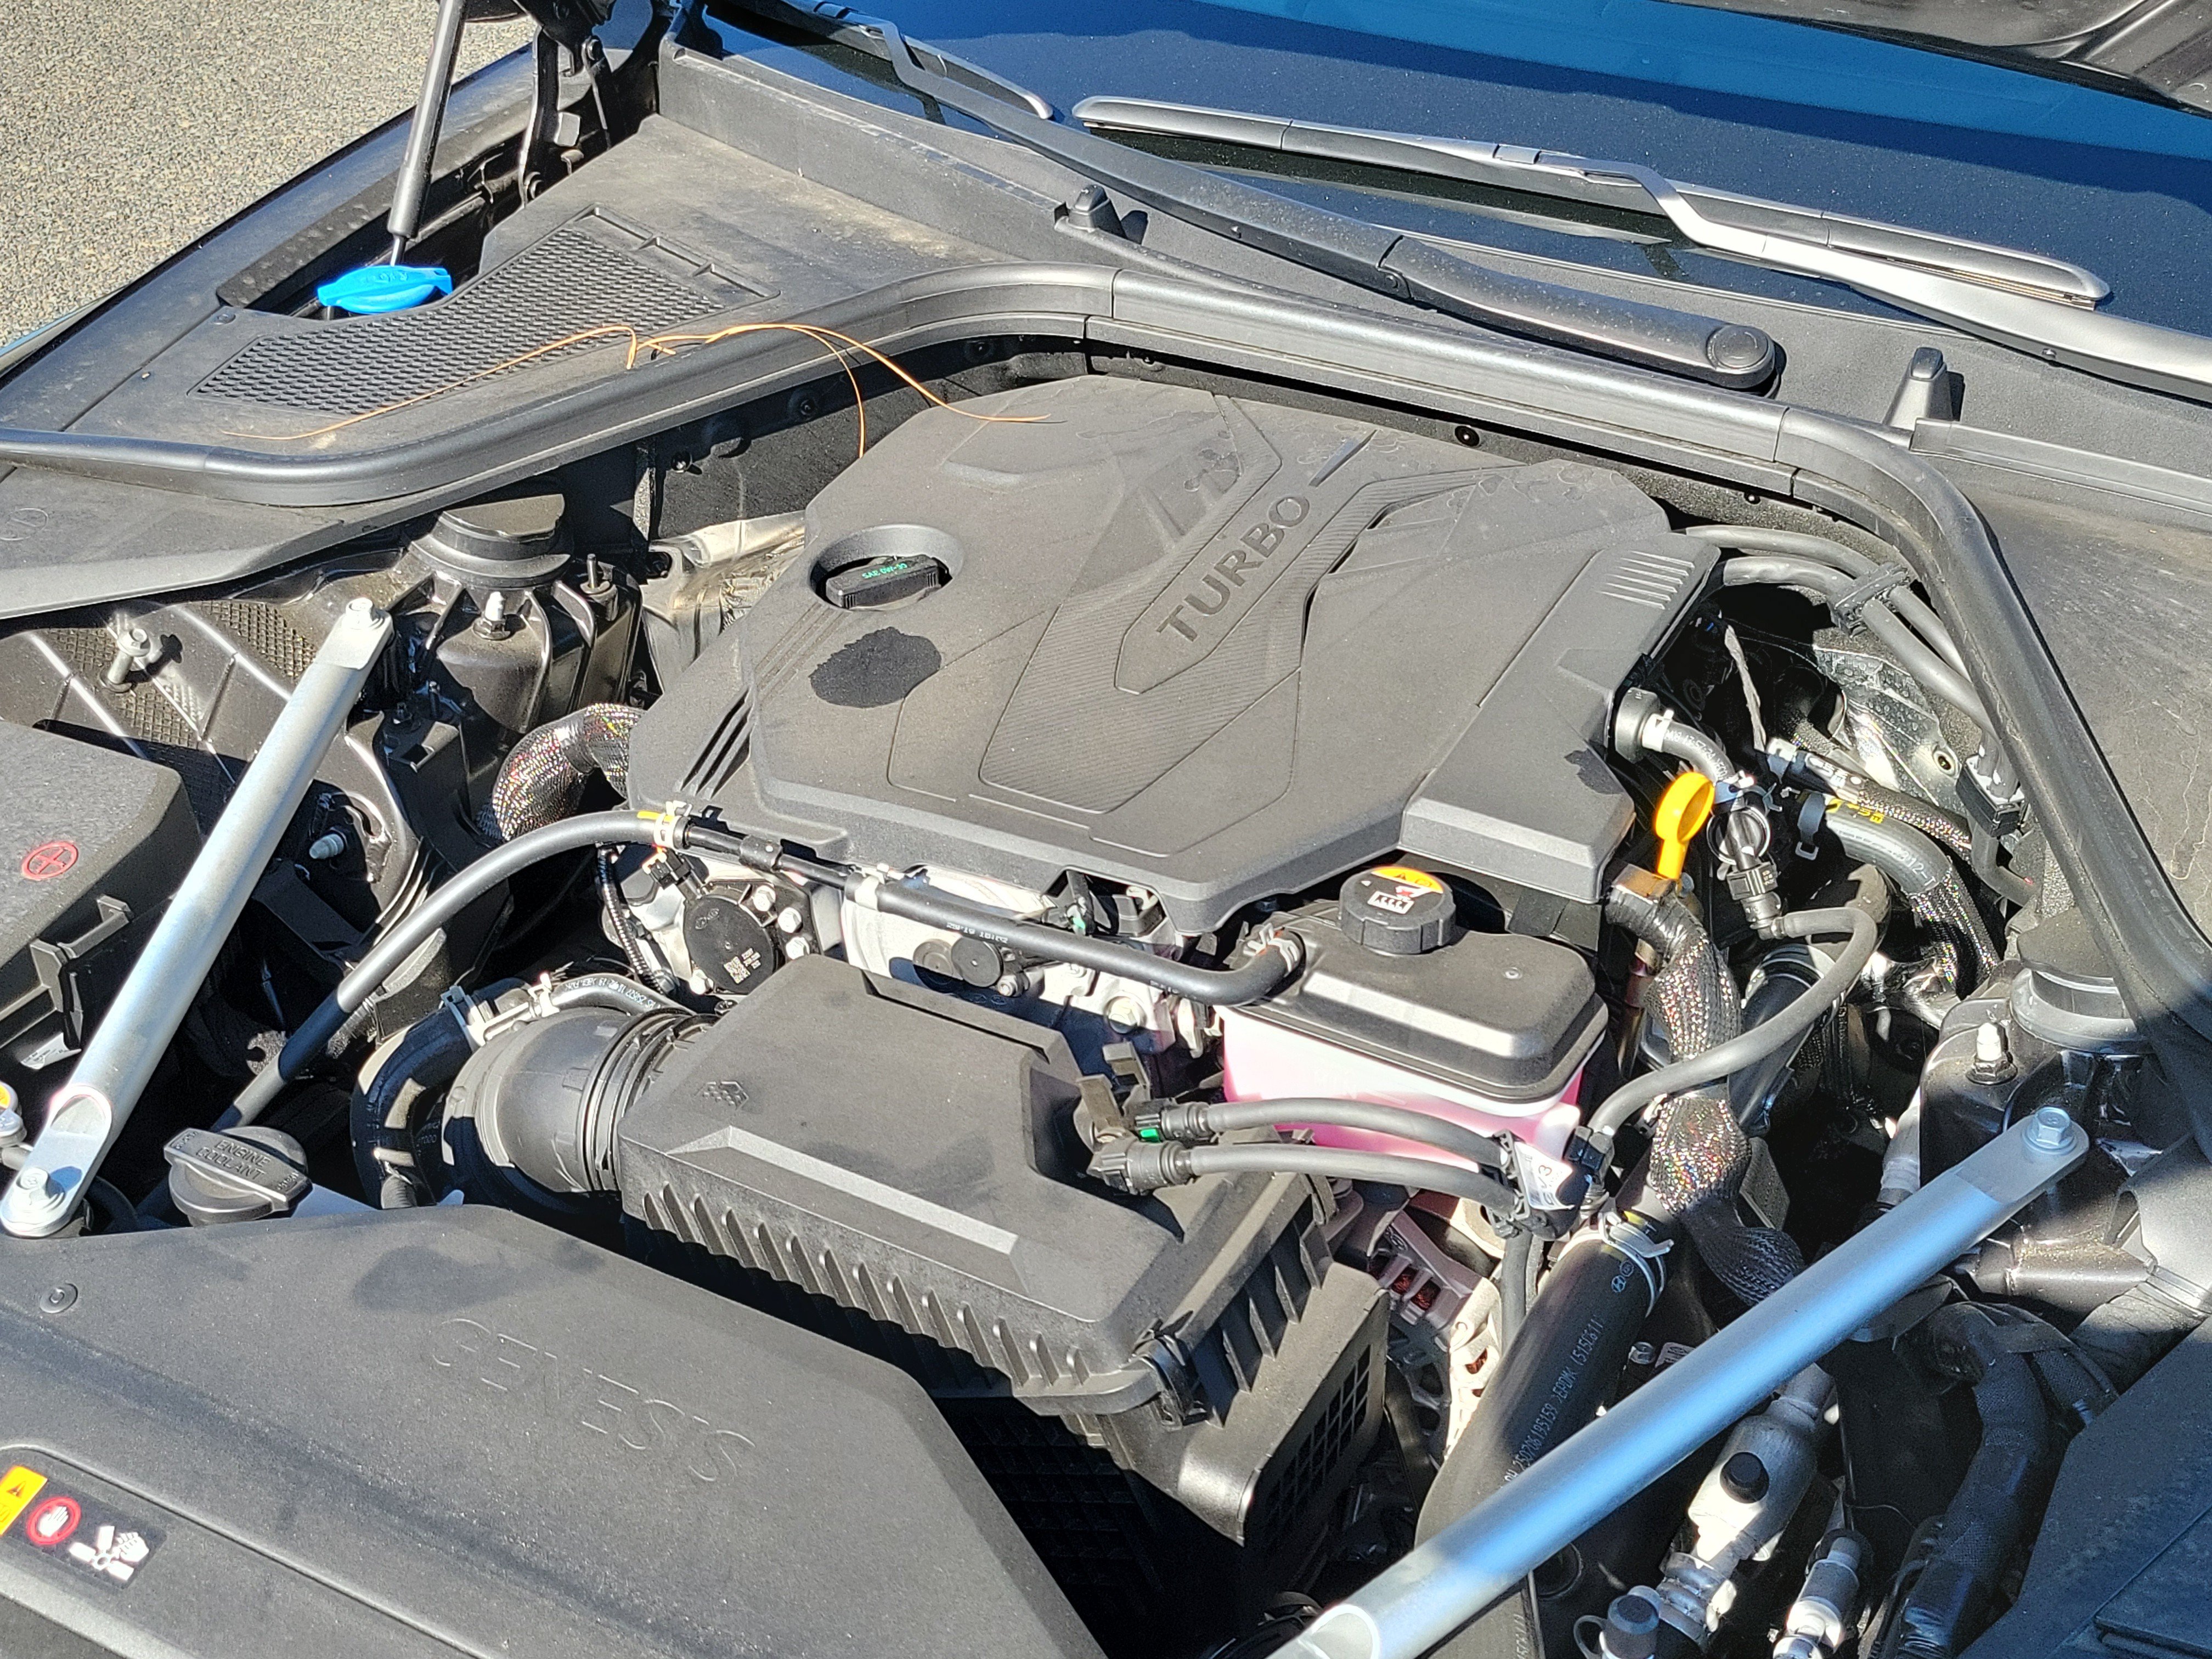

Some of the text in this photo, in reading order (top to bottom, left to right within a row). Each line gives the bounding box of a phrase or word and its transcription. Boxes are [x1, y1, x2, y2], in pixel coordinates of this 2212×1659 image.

[1156, 496, 1311, 642] TURBO
[195, 1146, 266, 1180] COOLANT
[215, 1139, 271, 1167] ENGINE
